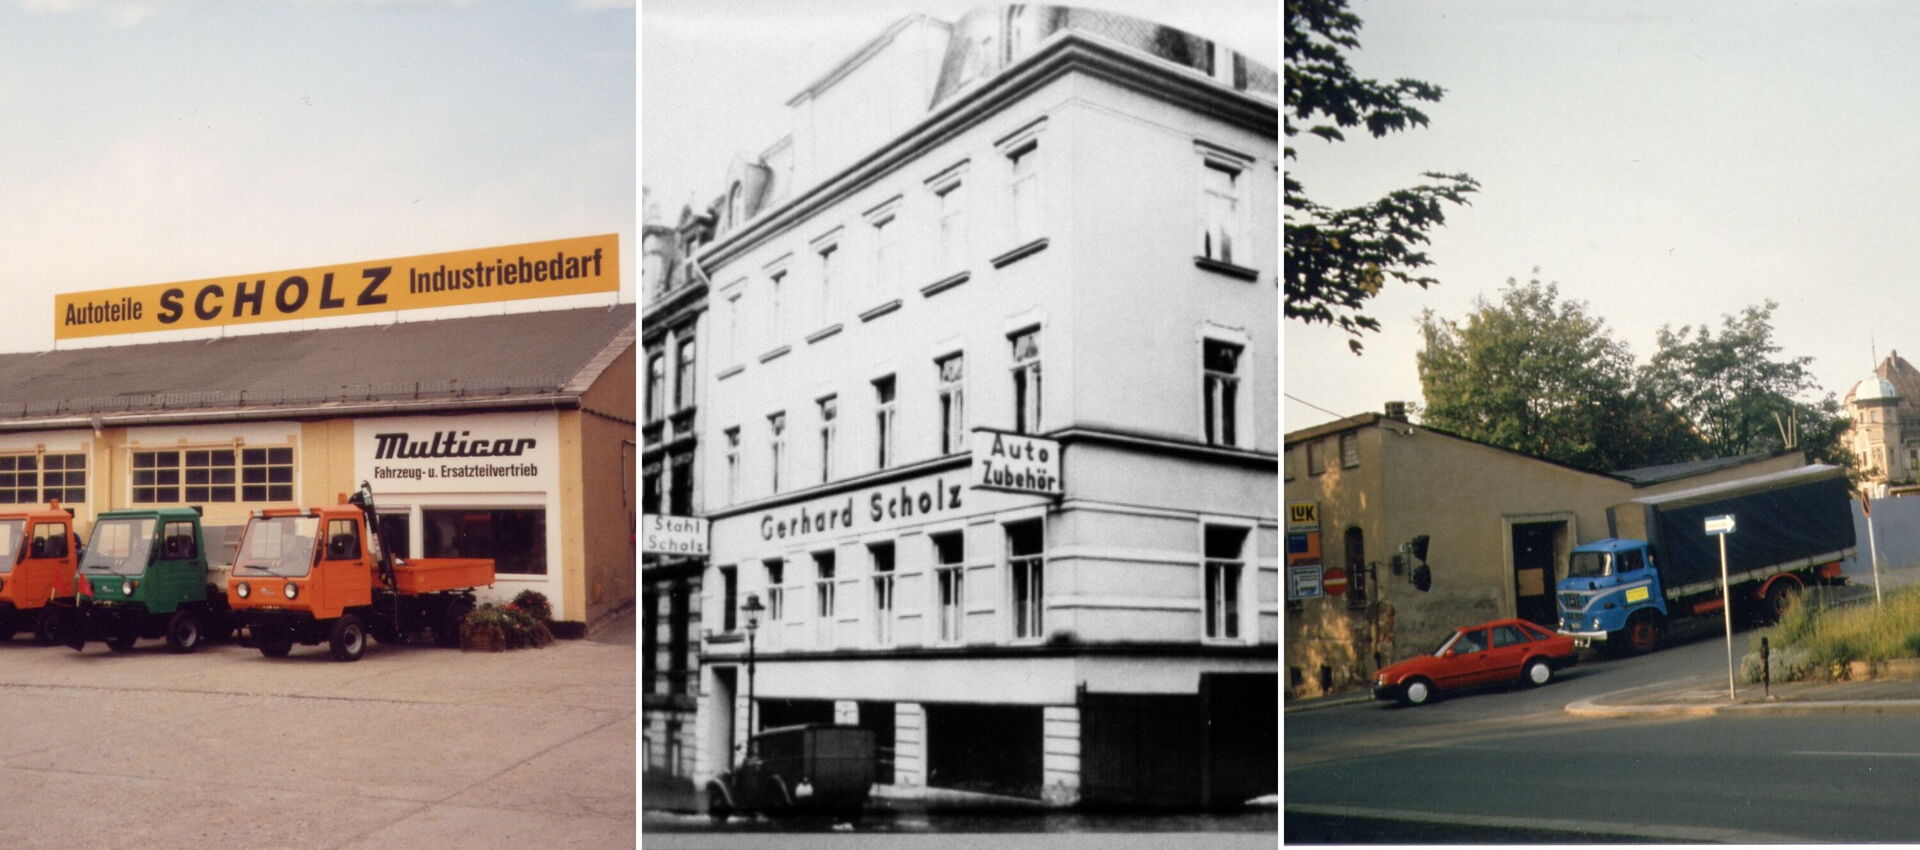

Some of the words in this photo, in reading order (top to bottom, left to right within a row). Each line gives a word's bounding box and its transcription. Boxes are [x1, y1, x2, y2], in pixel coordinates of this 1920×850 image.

[65, 297, 142, 326] Autoteile
[157, 266, 392, 324] SCHOLZ
[410, 248, 602, 294] Industriebedarf
[375, 431, 536, 459] Multicar
[991, 432, 1049, 463] Auto
[374, 466, 426, 480] Fahrzeug-
[428, 468, 438, 478] u.
[441, 463, 538, 478] Ersatzteilvertrieb
[983, 460, 1056, 491] Zubehör
[654, 515, 700, 533] Stahl
[761, 498, 853, 541] Gerhard
[870, 478, 961, 522] Scholz
[649, 535, 703, 552] Scholz
